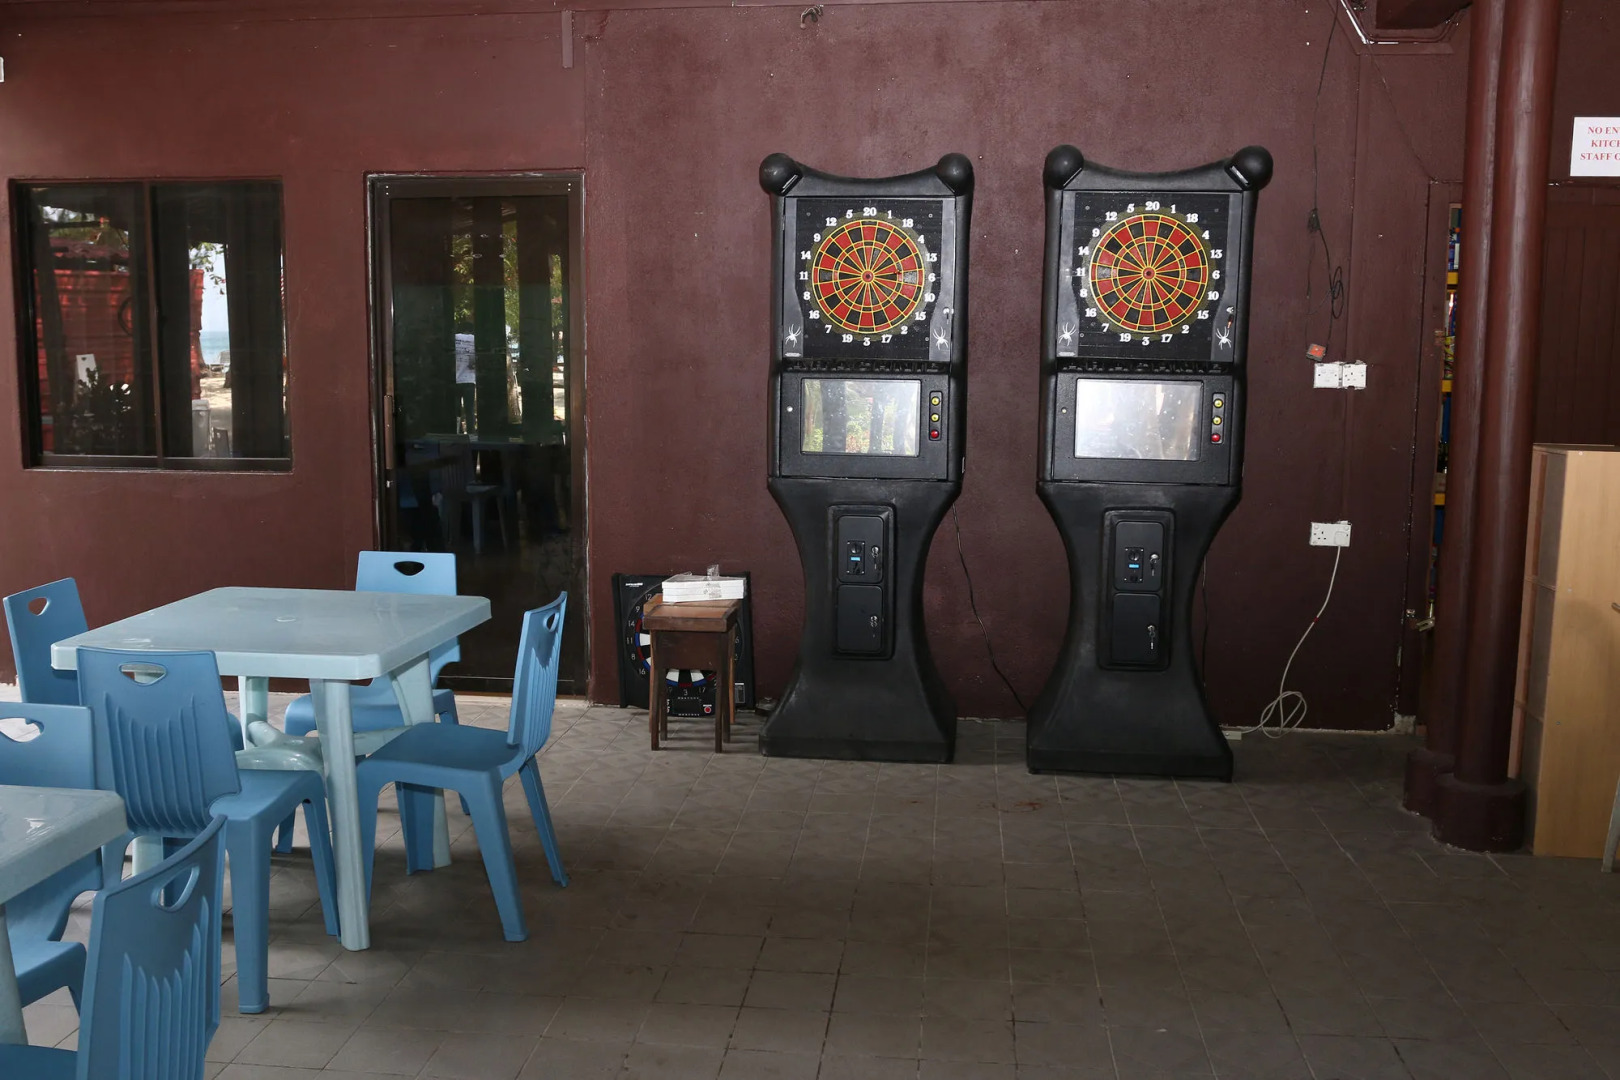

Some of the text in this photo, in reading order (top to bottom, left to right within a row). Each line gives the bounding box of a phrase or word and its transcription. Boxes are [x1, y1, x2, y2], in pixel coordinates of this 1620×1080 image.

[1588, 127, 1620, 135] NO EN
[1580, 153, 1612, 161] STAFF
[862, 206, 878, 217] 20
[1126, 203, 1135, 214] 5
[1144, 200, 1161, 212] 20
[1170, 204, 1177, 214] 1
[845, 209, 854, 220] 5
[887, 209, 893, 220] 1
[1105, 211, 1118, 223] 12
[1185, 212, 1199, 224] 18
[825, 216, 838, 227] 12
[901, 218, 914, 229] 18
[813, 232, 822, 243] 9
[1091, 227, 1101, 238] 9
[1201, 229, 1210, 240] 4
[916, 234, 925, 245] 4
[800, 250, 812, 260] 14
[1077, 246, 1090, 256] 14
[1209, 248, 1223, 259] 13
[925, 253, 938, 262] 13
[799, 270, 809, 281] 11
[927, 273, 936, 282] 6
[1075, 267, 1086, 277] 11
[1211, 269, 1221, 280] 6
[803, 290, 811, 301] 8
[924, 293, 936, 302] 10
[1079, 288, 1088, 298] 8
[1207, 290, 1220, 301] 10
[808, 309, 821, 320] 16
[914, 311, 927, 321] 15
[1084, 307, 1098, 318] 16
[1196, 309, 1210, 320] 15
[824, 324, 833, 334] 7
[900, 324, 909, 335] 2
[1101, 322, 1110, 333] 7
[1181, 324, 1190, 334] 2
[841, 333, 854, 343] 19
[862, 336, 871, 347] 3
[880, 333, 893, 344] 17
[1119, 332, 1132, 343] 19
[1141, 336, 1151, 346] 3
[1160, 333, 1173, 343] 17
[635, 605, 641, 613] 9
[626, 637, 633, 645] 11
[631, 653, 636, 661] 8
[682, 688, 688, 696] 3
